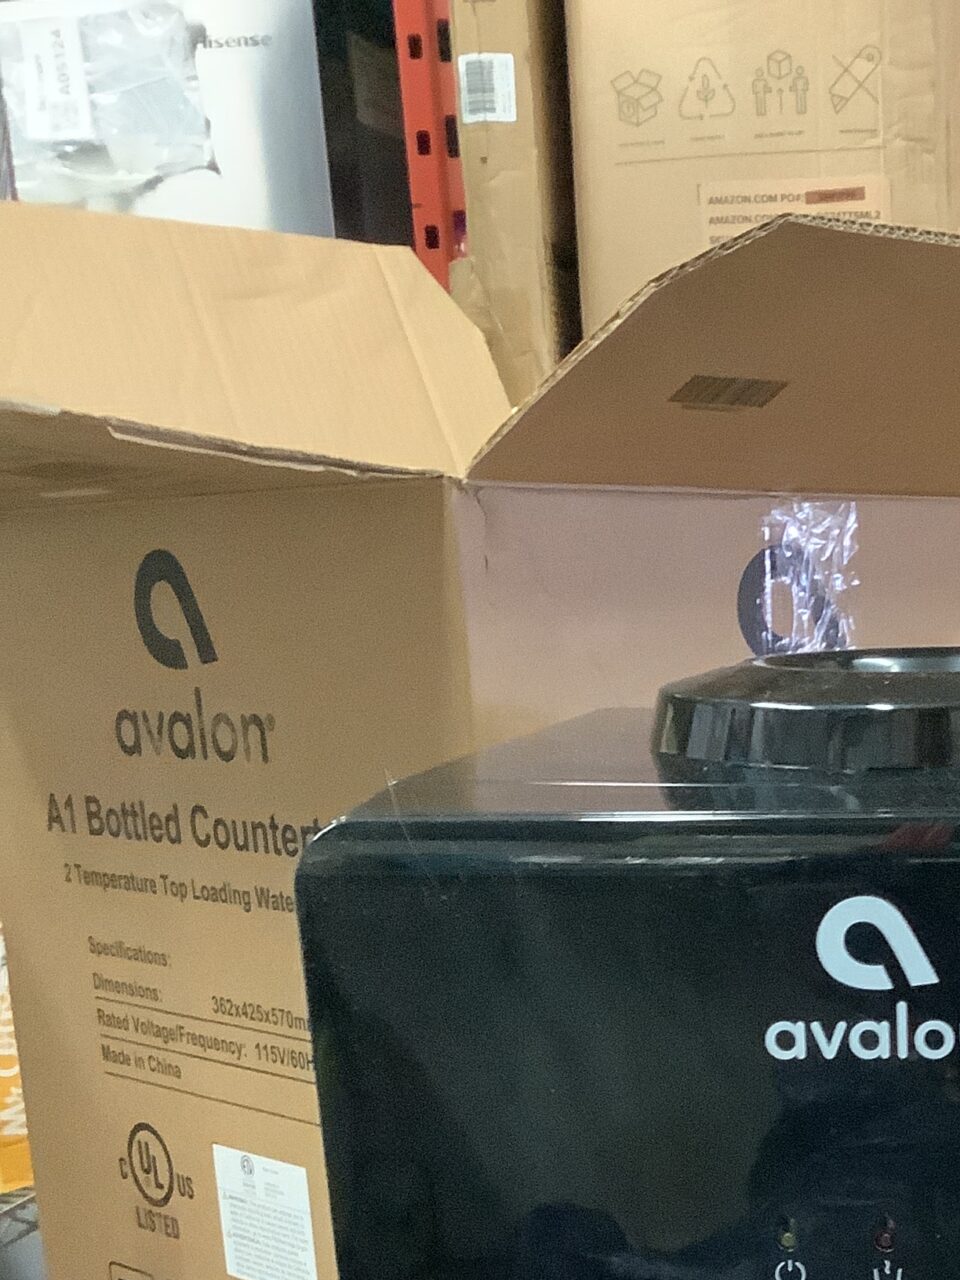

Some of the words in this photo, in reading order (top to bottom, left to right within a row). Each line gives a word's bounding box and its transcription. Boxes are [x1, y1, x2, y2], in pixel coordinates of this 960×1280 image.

[708, 193, 778, 206] AMAZON.COM
[115, 686, 269, 764] avalon
[48, 793, 77, 834] A1
[84, 794, 182, 845] Bottled
[64, 862, 73, 884] 2
[73, 863, 158, 896] Temperature
[159, 874, 188, 903] Top
[191, 879, 252, 913] Loading
[88, 935, 172, 968] Specifications:
[92, 972, 163, 1002] Dimensions:
[97, 1007, 130, 1031] Rated
[131, 1015, 248, 1061] Voltage/Frequency:
[101, 1043, 132, 1067] Made
[134, 1052, 145, 1069] in
[147, 1055, 182, 1080] China
[137, 1139, 165, 1190] UL
[176, 1172, 194, 1200] US
[135, 1205, 180, 1240] LISTED
